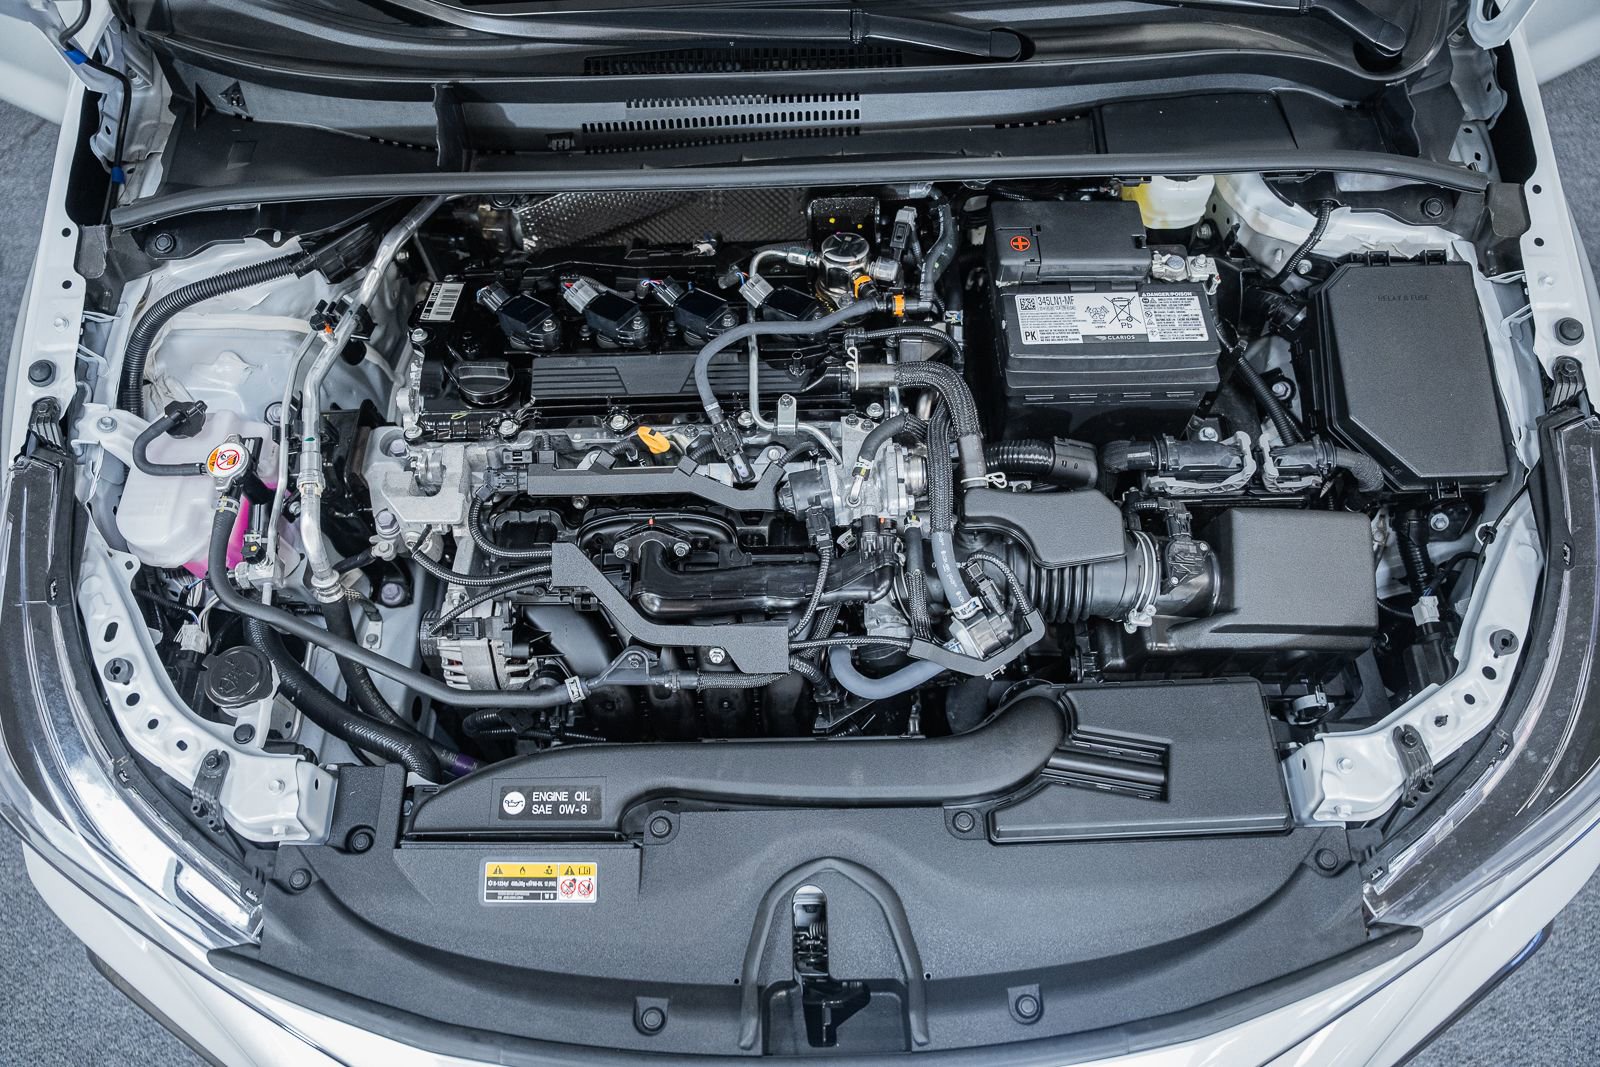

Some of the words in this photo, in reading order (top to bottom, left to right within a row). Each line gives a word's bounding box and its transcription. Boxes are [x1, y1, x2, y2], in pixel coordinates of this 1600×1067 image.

[1025, 331, 1037, 341] PK
[532, 791, 569, 801] ENGINE
[574, 791, 591, 801] OIL
[531, 804, 552, 815] SAE
[559, 804, 588, 815] 0W-8
